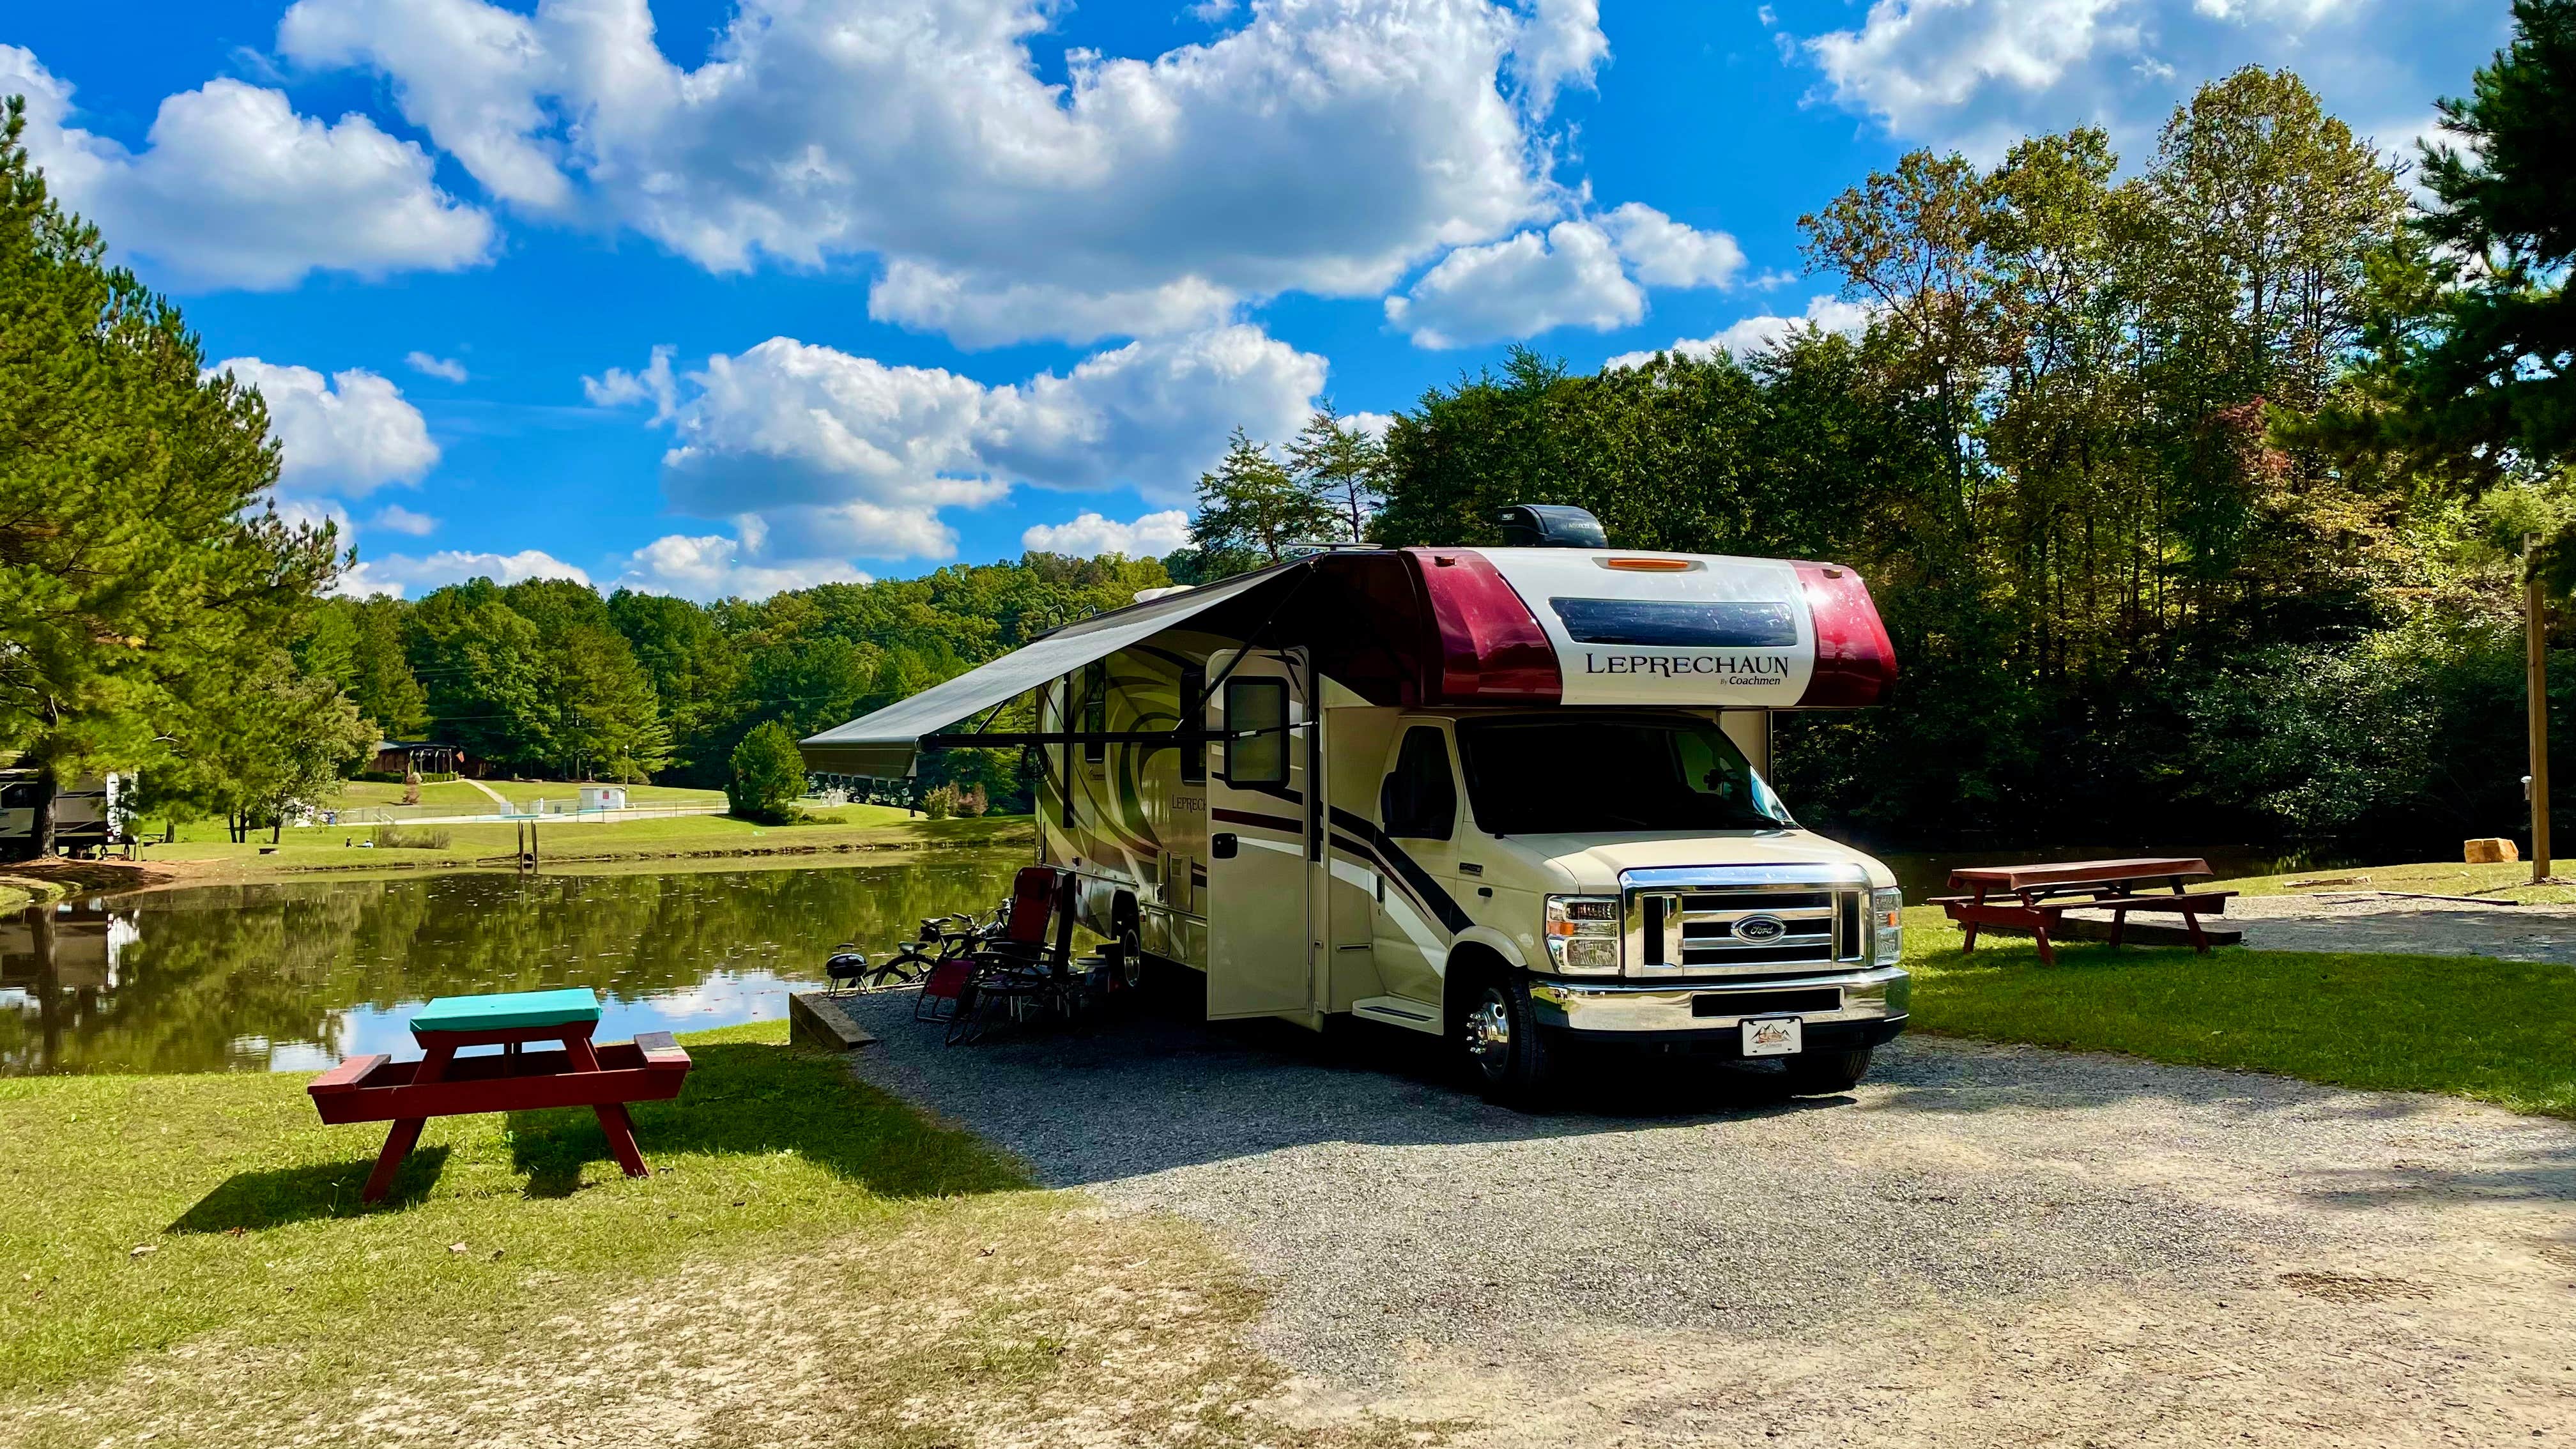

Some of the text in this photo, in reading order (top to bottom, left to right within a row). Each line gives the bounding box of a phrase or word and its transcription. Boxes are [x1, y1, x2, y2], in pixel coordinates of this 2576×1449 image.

[1586, 653, 1788, 678] LEPRECHAUN
[1729, 676, 1781, 685] Coachmen
[1751, 925, 1774, 935] Ford
